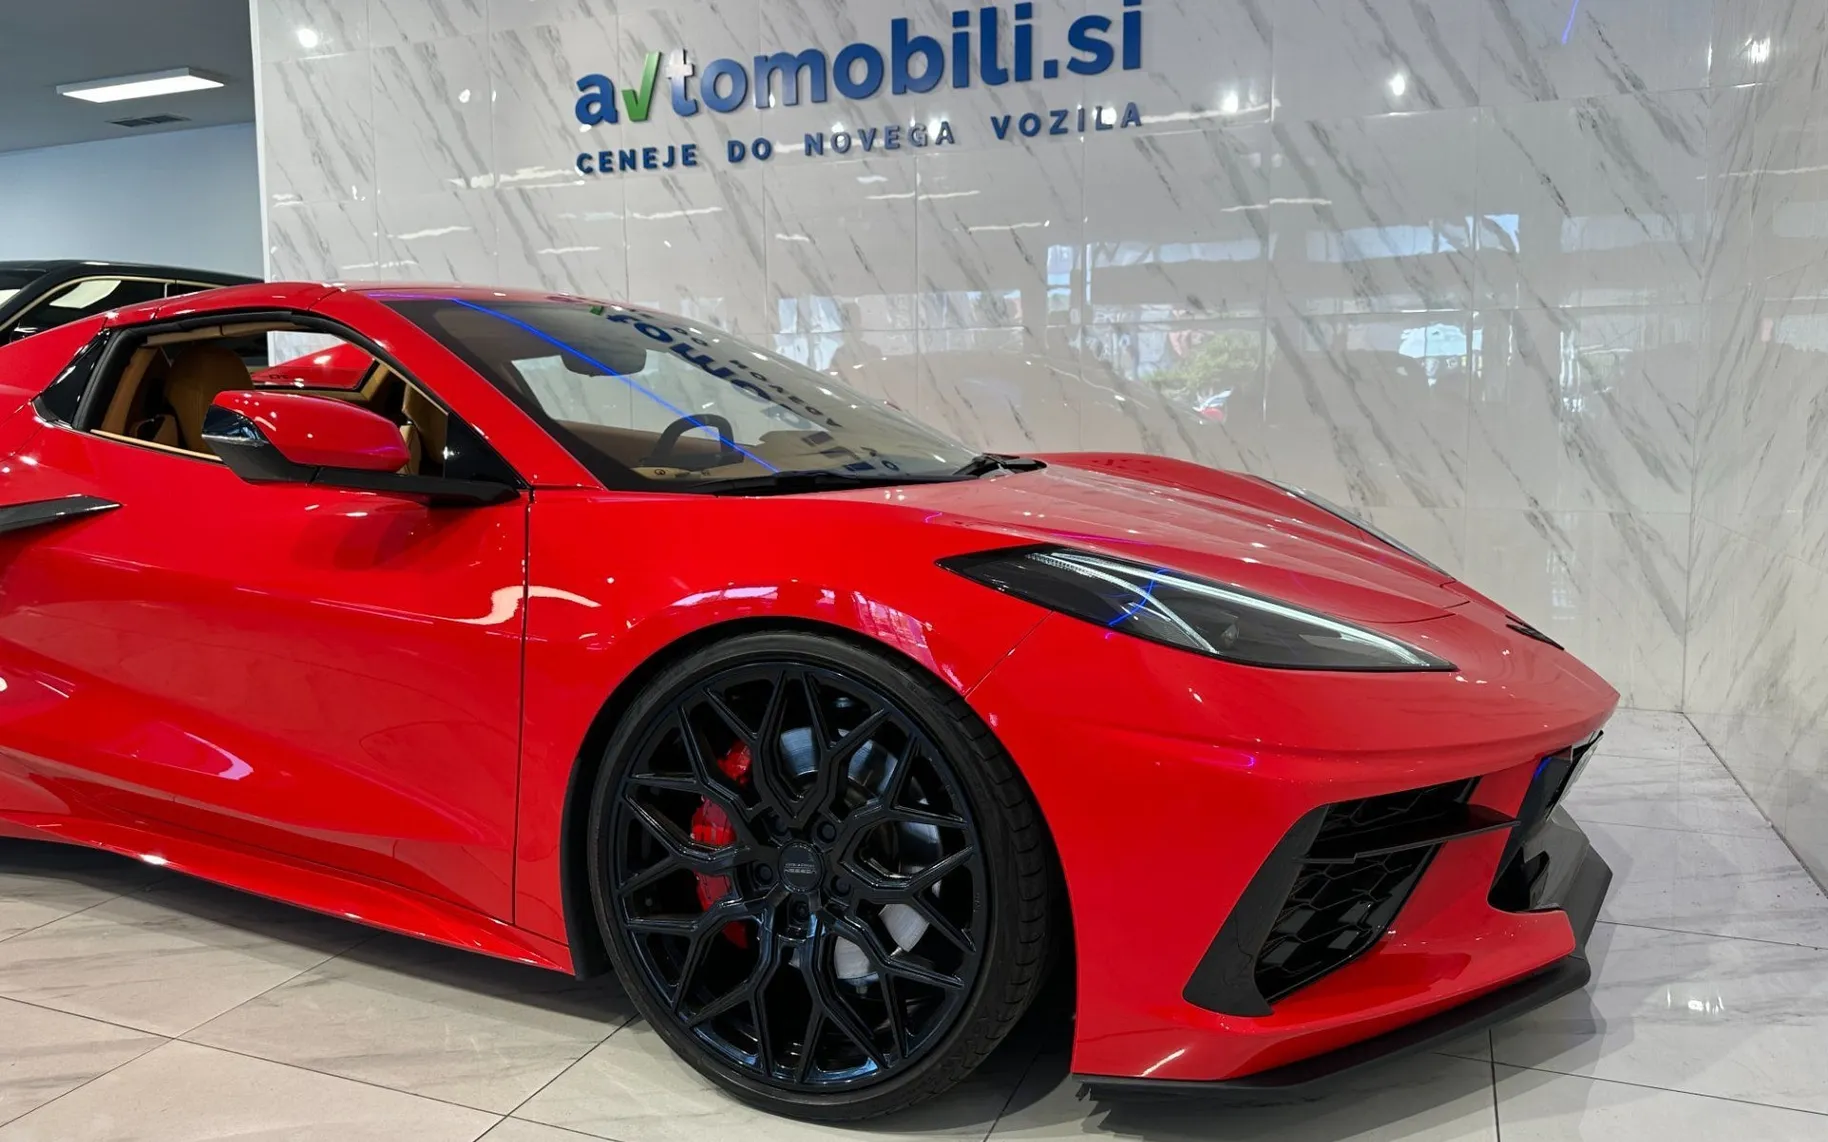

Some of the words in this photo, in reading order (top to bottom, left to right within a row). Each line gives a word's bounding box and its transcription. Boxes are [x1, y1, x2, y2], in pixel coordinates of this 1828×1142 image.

[576, 144, 699, 174] CENEJE
[727, 137, 772, 163] DO
[804, 121, 955, 157] NOVEGA
[990, 102, 1142, 140] VOZILA
